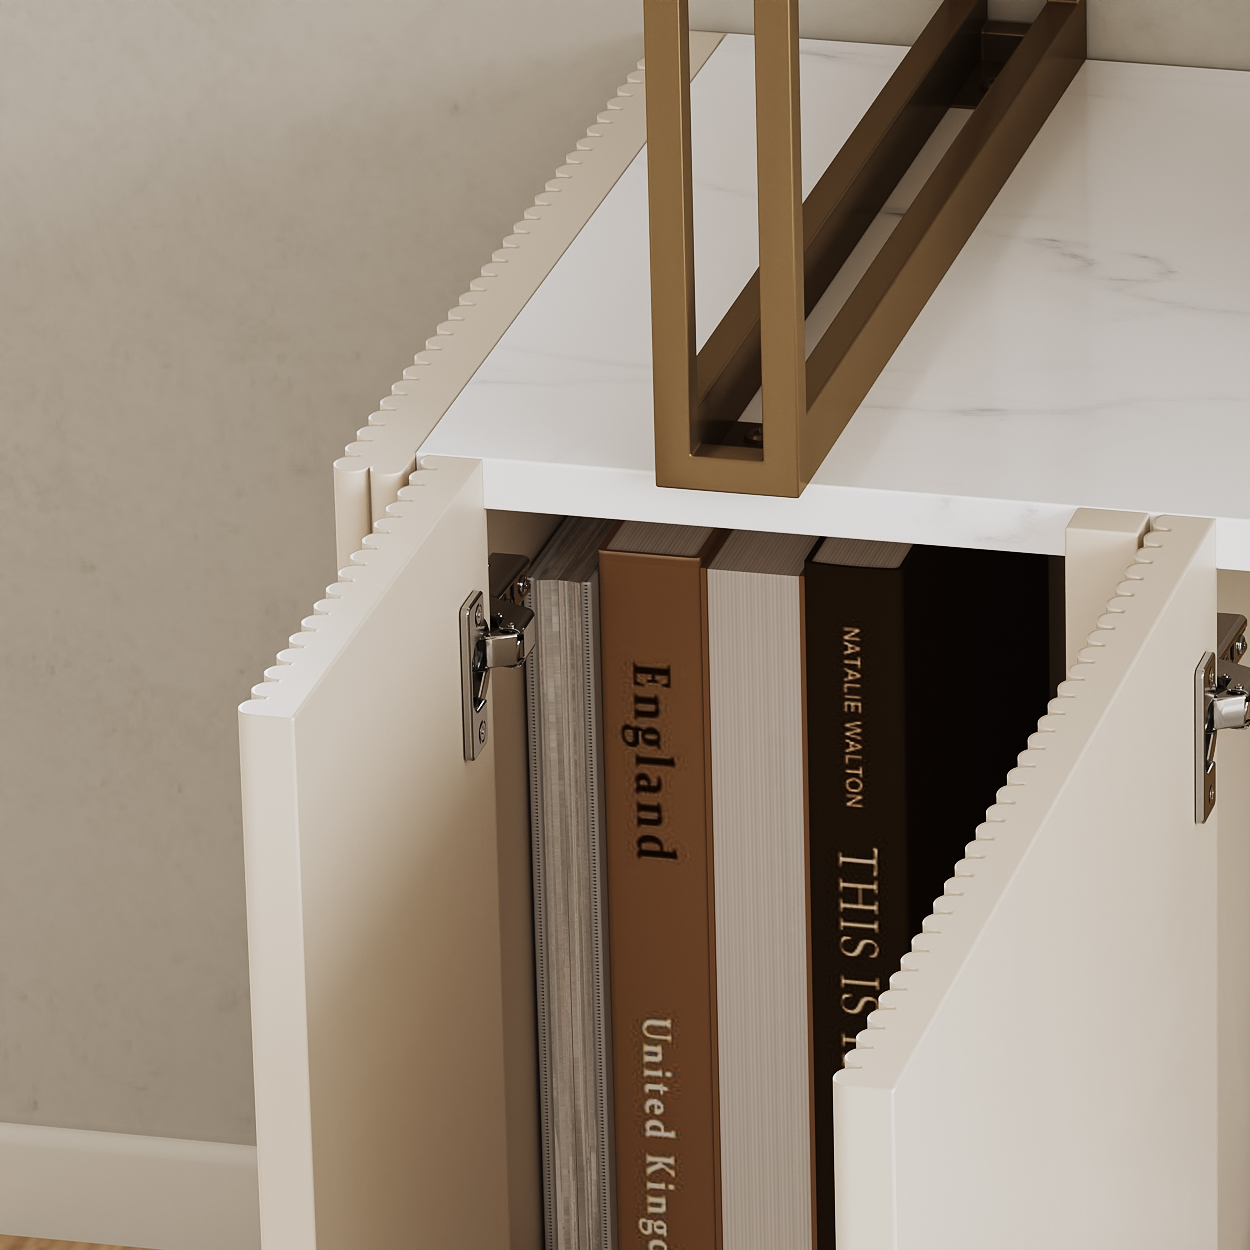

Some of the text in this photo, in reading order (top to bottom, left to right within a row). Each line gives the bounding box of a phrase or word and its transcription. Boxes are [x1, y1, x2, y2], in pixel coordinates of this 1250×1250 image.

[621, 661, 678, 861] England
[843, 626, 863, 808] NATALIE WALTON
[839, 848, 880, 1014] THIS IS
[642, 1018, 677, 1140] United
